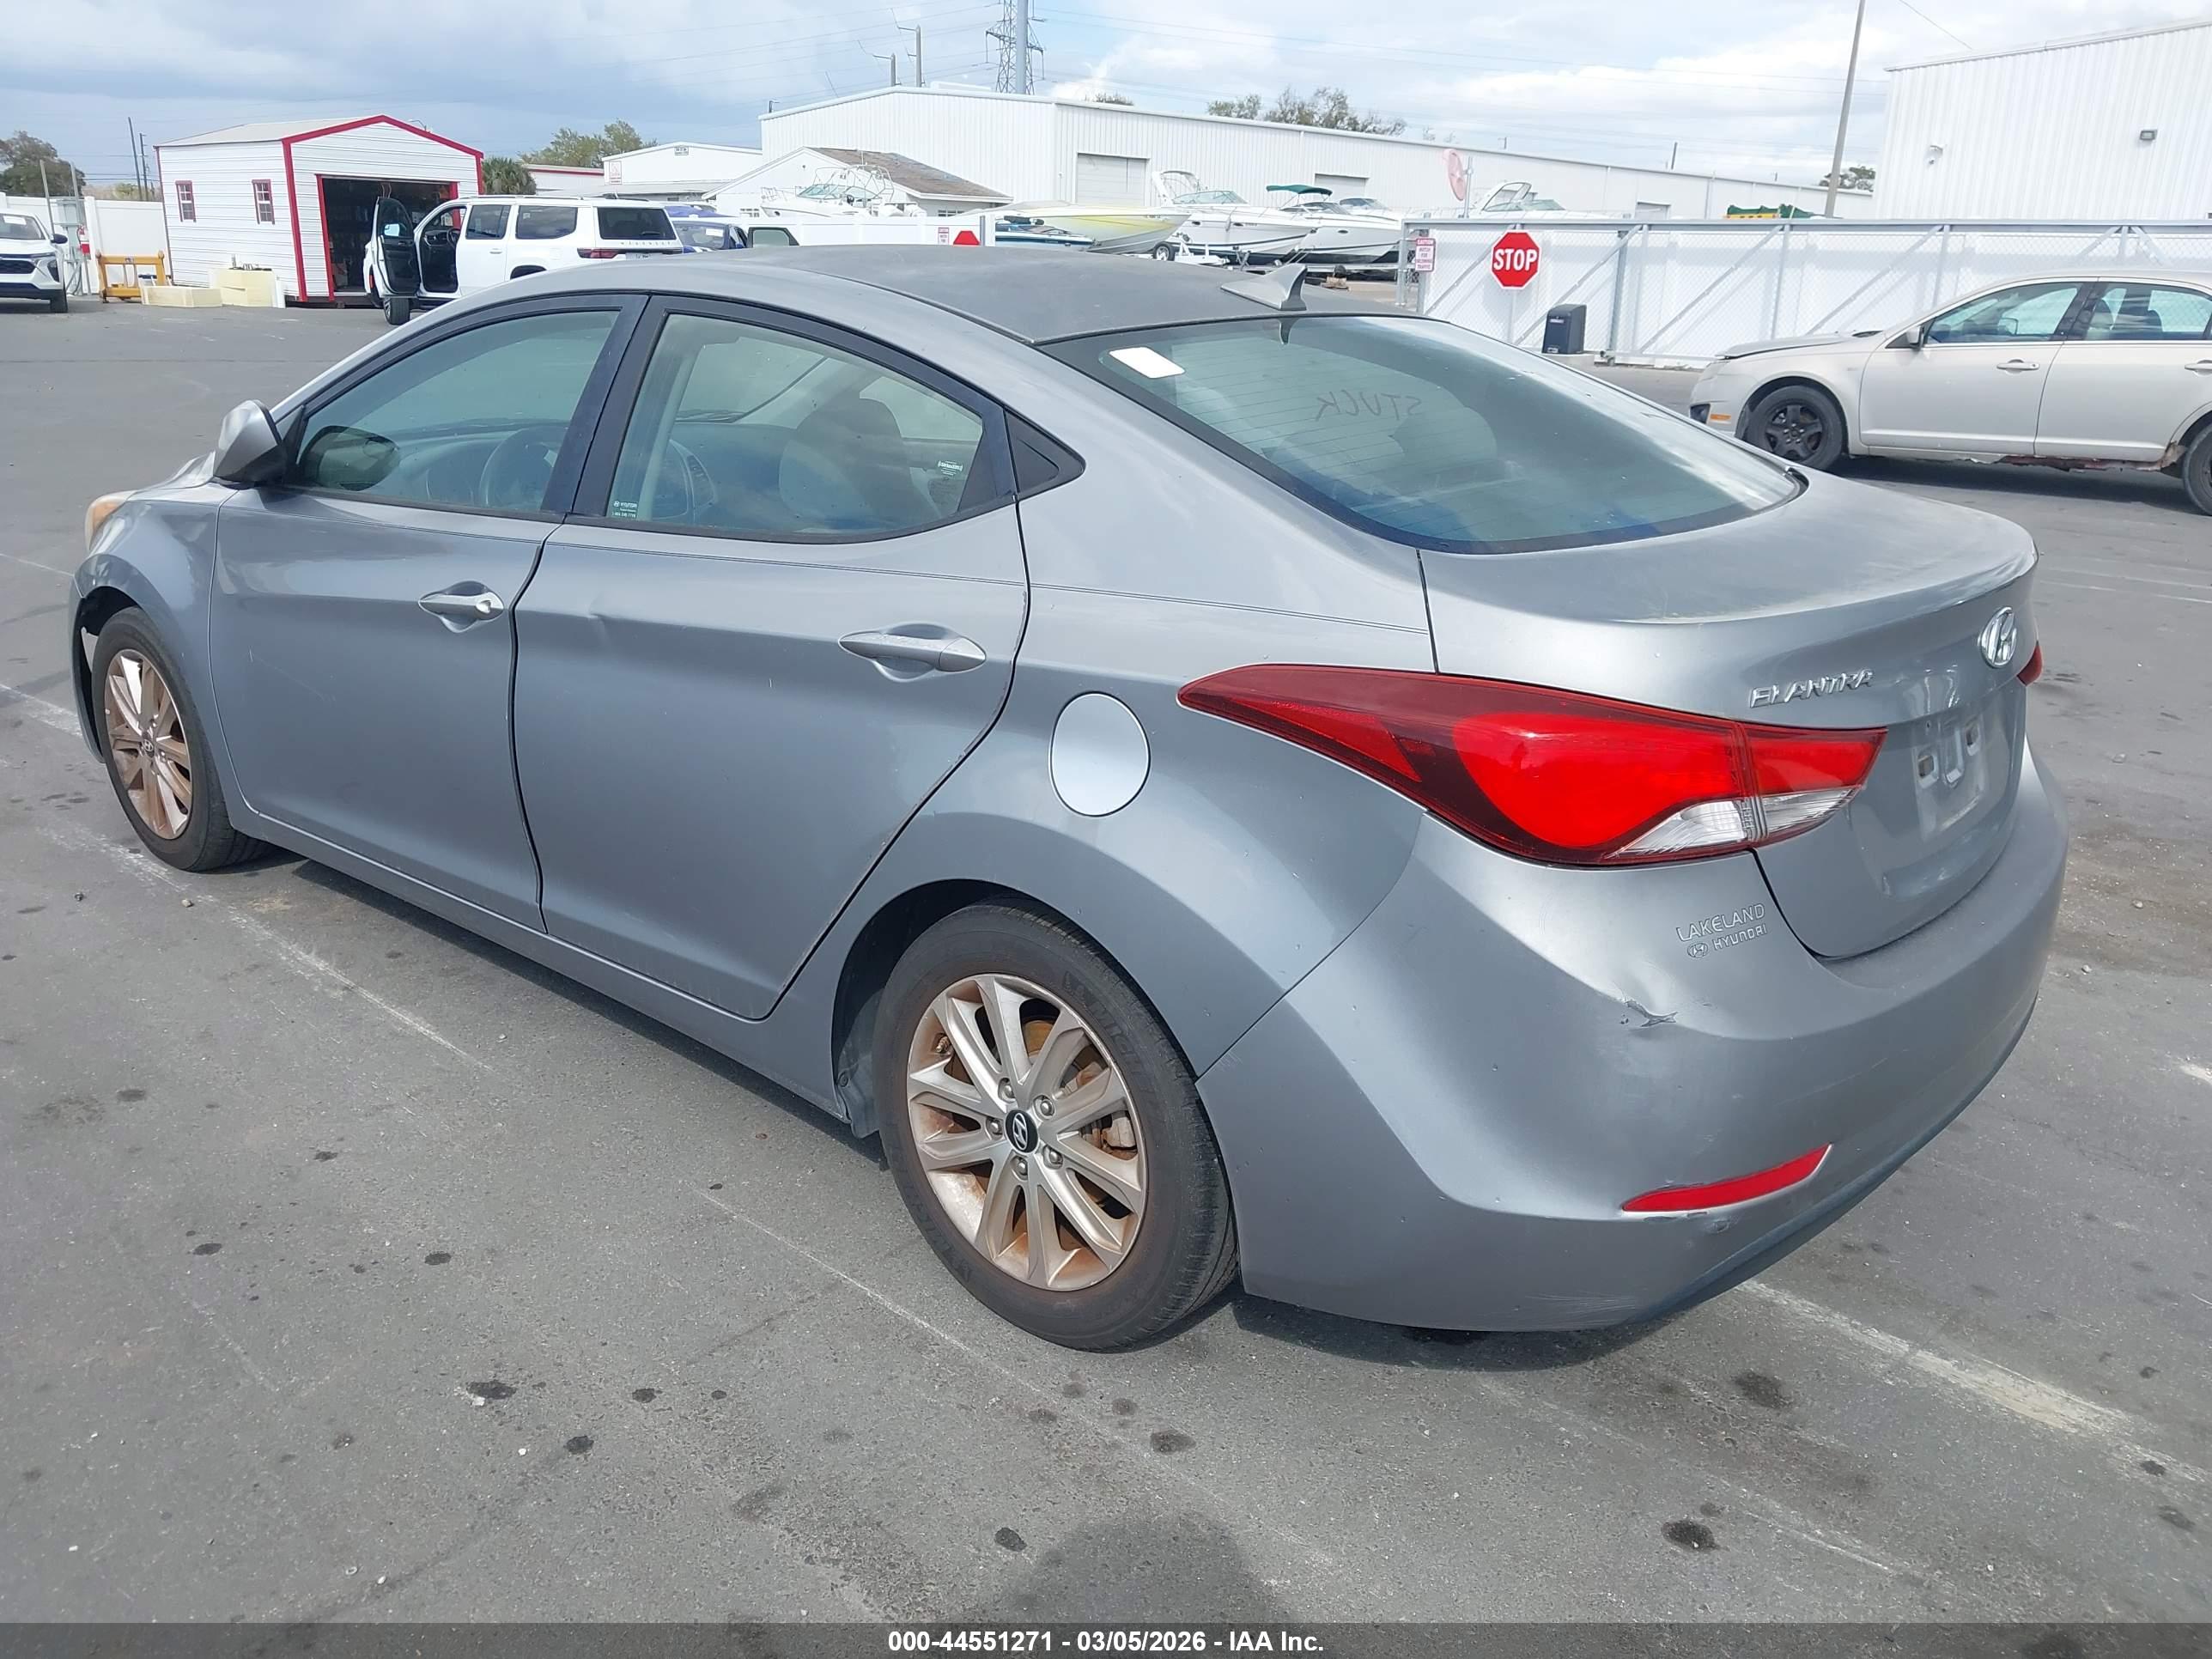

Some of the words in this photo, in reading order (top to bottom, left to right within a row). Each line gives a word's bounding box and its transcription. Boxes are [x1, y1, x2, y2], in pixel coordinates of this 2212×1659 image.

[1493, 248, 1537, 271] STOP
[1750, 669, 1874, 708] ELANTRA
[1676, 903, 1765, 941] LAKELAND
[1712, 924, 1767, 950] HYUNDAI
